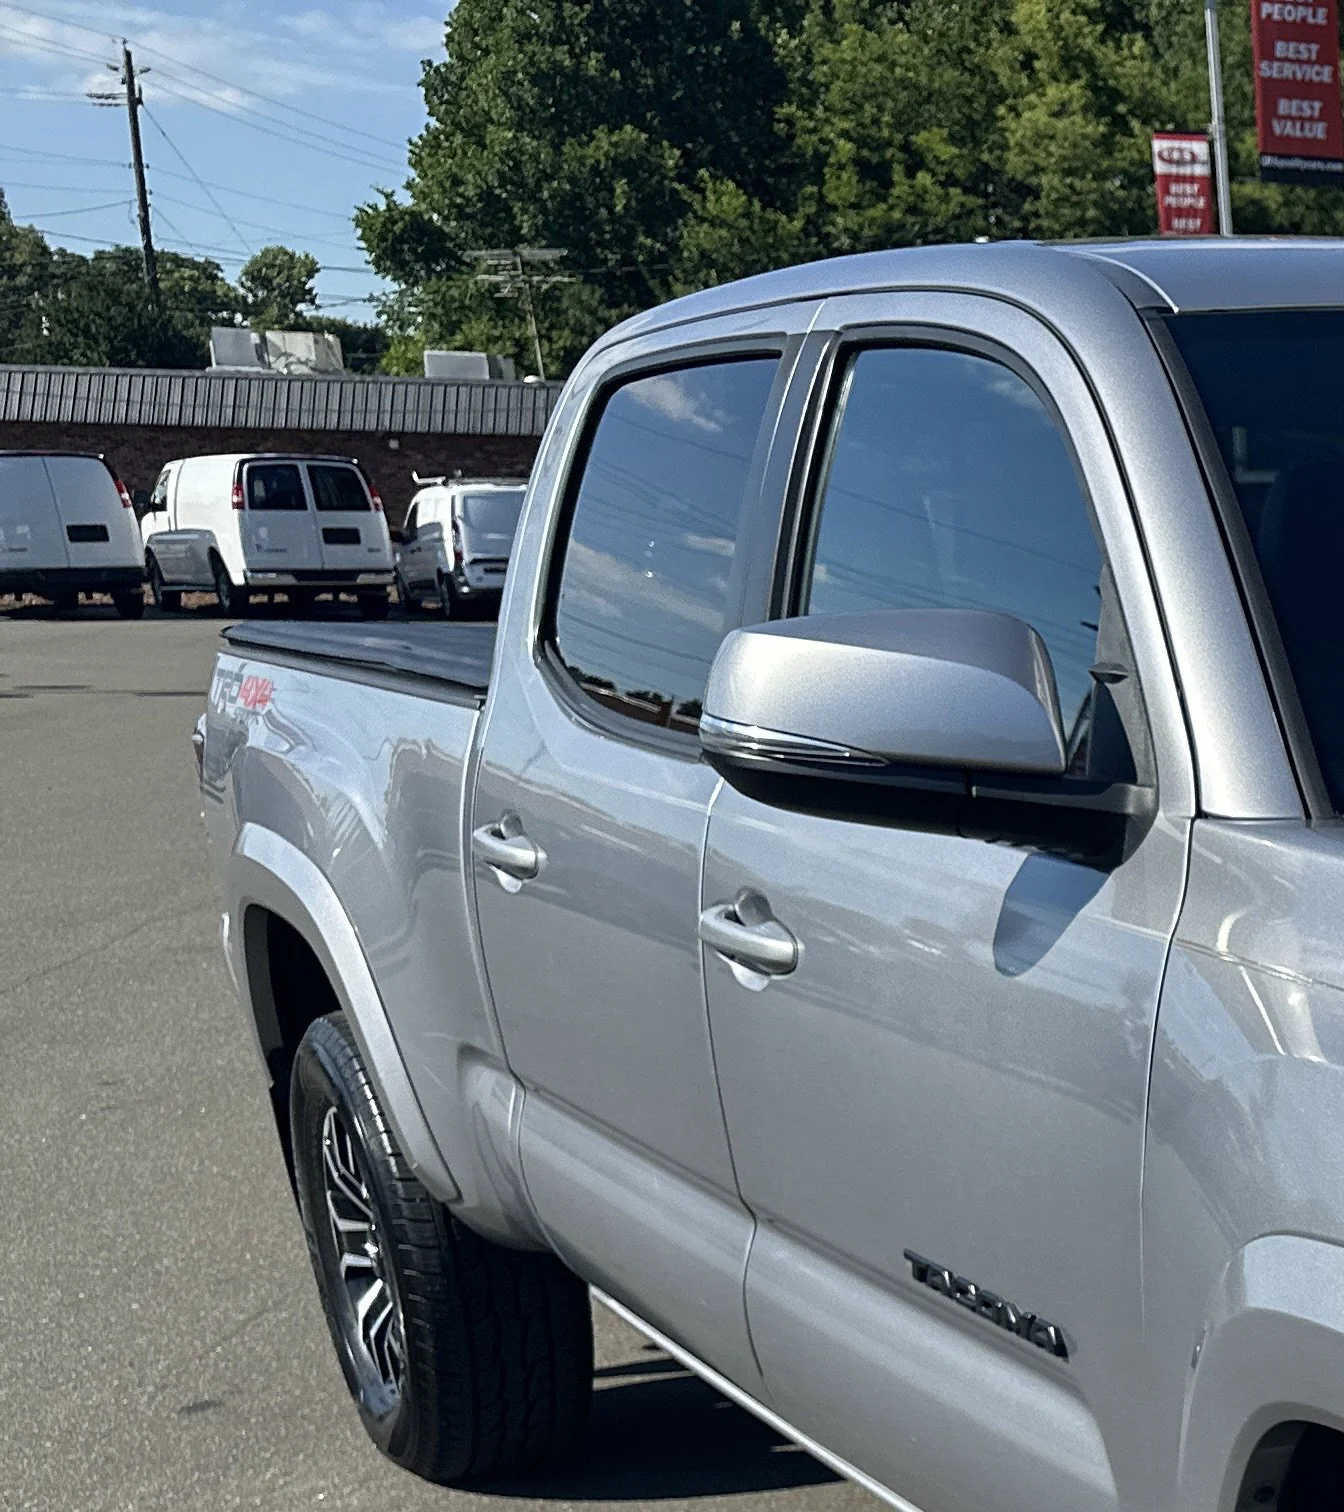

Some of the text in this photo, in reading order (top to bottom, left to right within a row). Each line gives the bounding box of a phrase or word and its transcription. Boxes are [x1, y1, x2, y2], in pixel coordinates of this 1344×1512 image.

[1260, 3, 1328, 26] PEOPLE
[1274, 40, 1320, 61] BEST
[1259, 60, 1334, 83] SERVICE
[1276, 98, 1323, 119] BEST
[1271, 119, 1328, 141] VALUE
